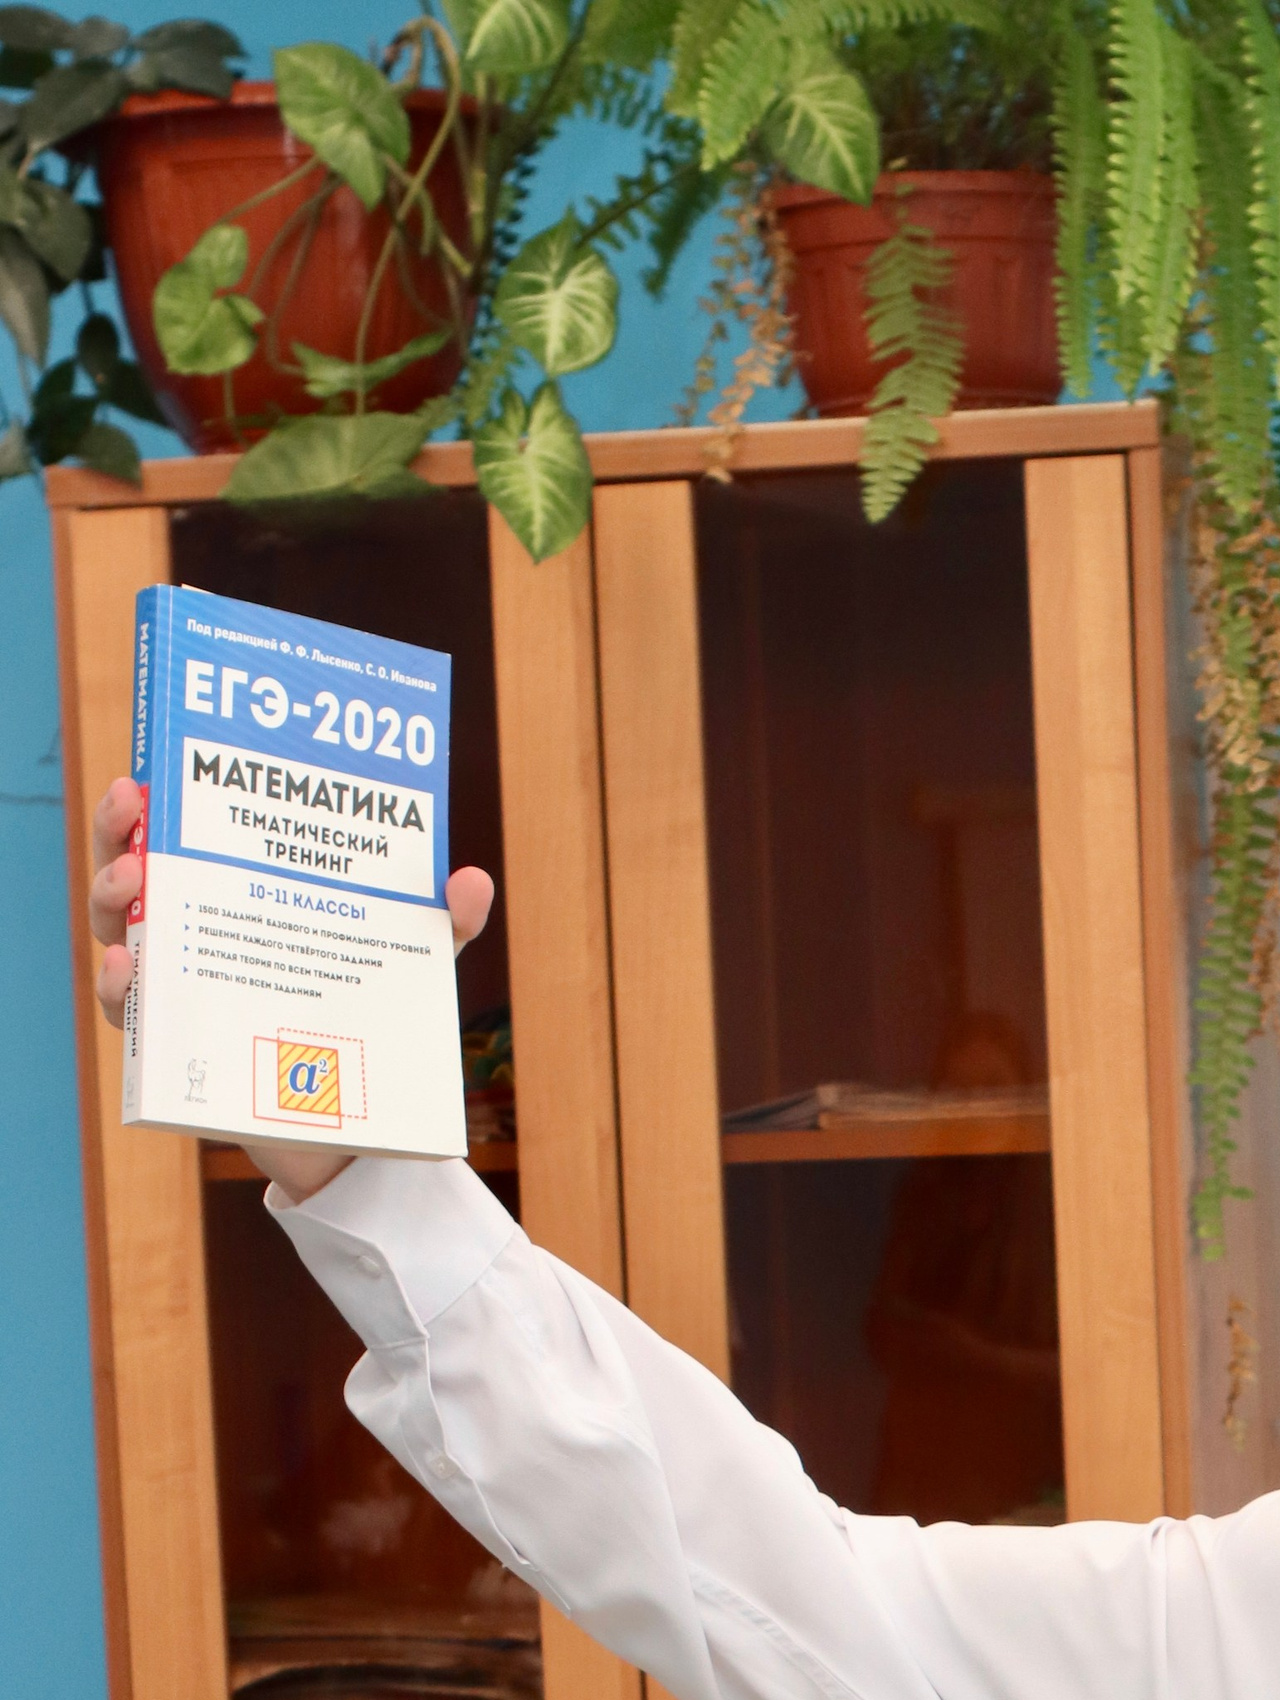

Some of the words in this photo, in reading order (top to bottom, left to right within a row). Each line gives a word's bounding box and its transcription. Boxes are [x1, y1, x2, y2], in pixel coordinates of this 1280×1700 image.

[187, 618, 212, 637] Под
[214, 626, 277, 651] редакцией
[280, 641, 293, 656] Ф.
[296, 645, 309, 660] Ф.
[311, 648, 364, 675] Лысенко,
[366, 663, 376, 676] С.
[378, 667, 389, 680] О.
[391, 669, 437, 692] Иванова
[136, 622, 150, 772] МАТЕМАТИКА
[185, 659, 435, 766] ЕГЭ-2020
[193, 749, 425, 833] МАТЕМАТИКА
[229, 805, 389, 858] ТЕМАТИЧЕСКИЙ
[264, 838, 353, 874] ТРЕНИНГ
[248, 882, 288, 905] 10-11
[292, 892, 366, 920] КЛАССЫ
[198, 904, 219, 917] 1500
[221, 907, 263, 925] ЗАДАНИЙ
[266, 918, 310, 935] БАЗОВОГО
[312, 928, 319, 936] И
[320, 929, 388, 949] ПРОФИЛЬНОГО
[389, 941, 431, 956] УРОВНЕЙ
[198, 925, 241, 942] РЕШЕНИЕ
[243, 934, 284, 950] КАЖДОГО
[285, 942, 338, 961] ЧЕТВЁРТОГО
[339, 954, 383, 968] ЗАДАНИЯ
[197, 968, 233, 982] ОТВЕТЫ
[235, 975, 247, 985] КО
[249, 977, 272, 990] ВСЕМ
[273, 983, 322, 999] ЗАДАНИЯМ
[198, 947, 238, 962] КРАТКАЯ
[240, 954, 273, 969] ТЕОРИЯ
[274, 961, 286, 972] ПО
[288, 964, 312, 976] ВСЕМ
[313, 969, 344, 982] ТЕМАМ
[345, 975, 361, 985] ЕГЭ
